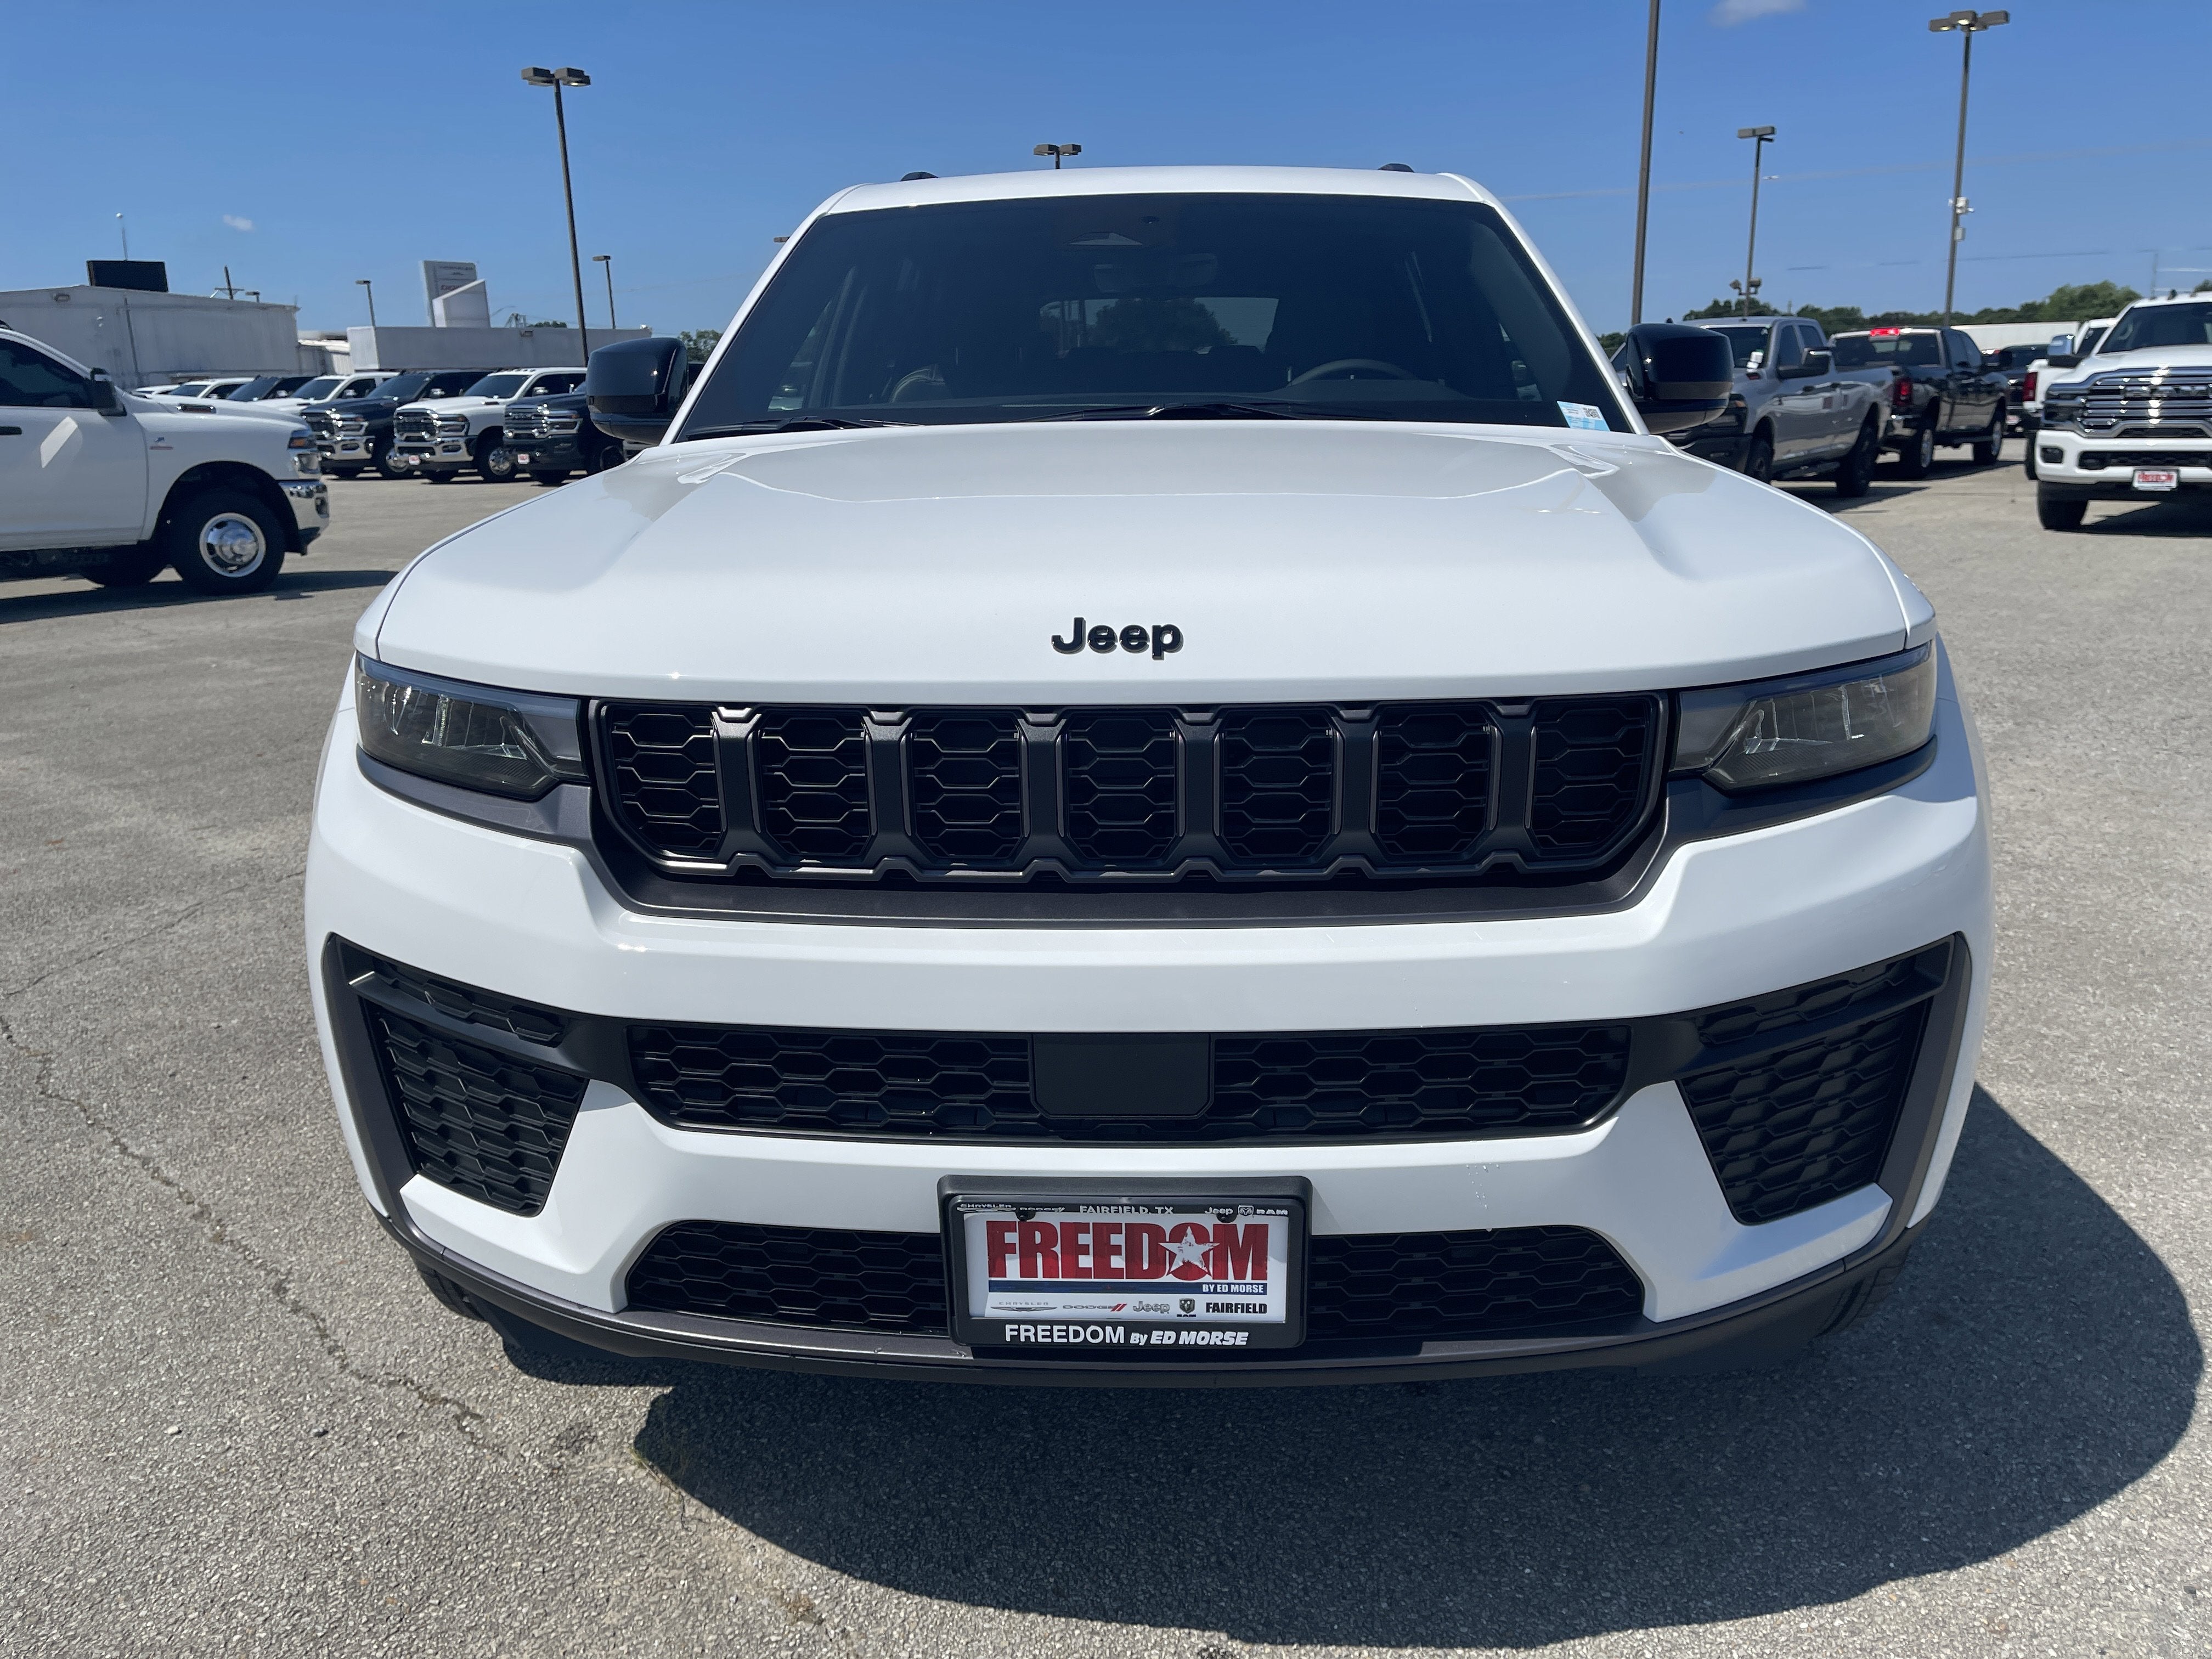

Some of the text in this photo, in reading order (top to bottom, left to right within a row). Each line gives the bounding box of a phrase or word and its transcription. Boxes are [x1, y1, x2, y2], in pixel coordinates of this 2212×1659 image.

[1051, 617, 1184, 661] Jeep
[1155, 1206, 1173, 1215] TX
[1204, 1207, 1233, 1215] Jeep
[986, 1221, 1269, 1280] FREEDOM
[1202, 1284, 1264, 1293] BY ED MORSE
[1133, 1301, 1170, 1313] Jeep
[1206, 1302, 1267, 1314] FAIRFIELD
[1005, 1324, 1249, 1345] FREEDOM By ED MORSE
